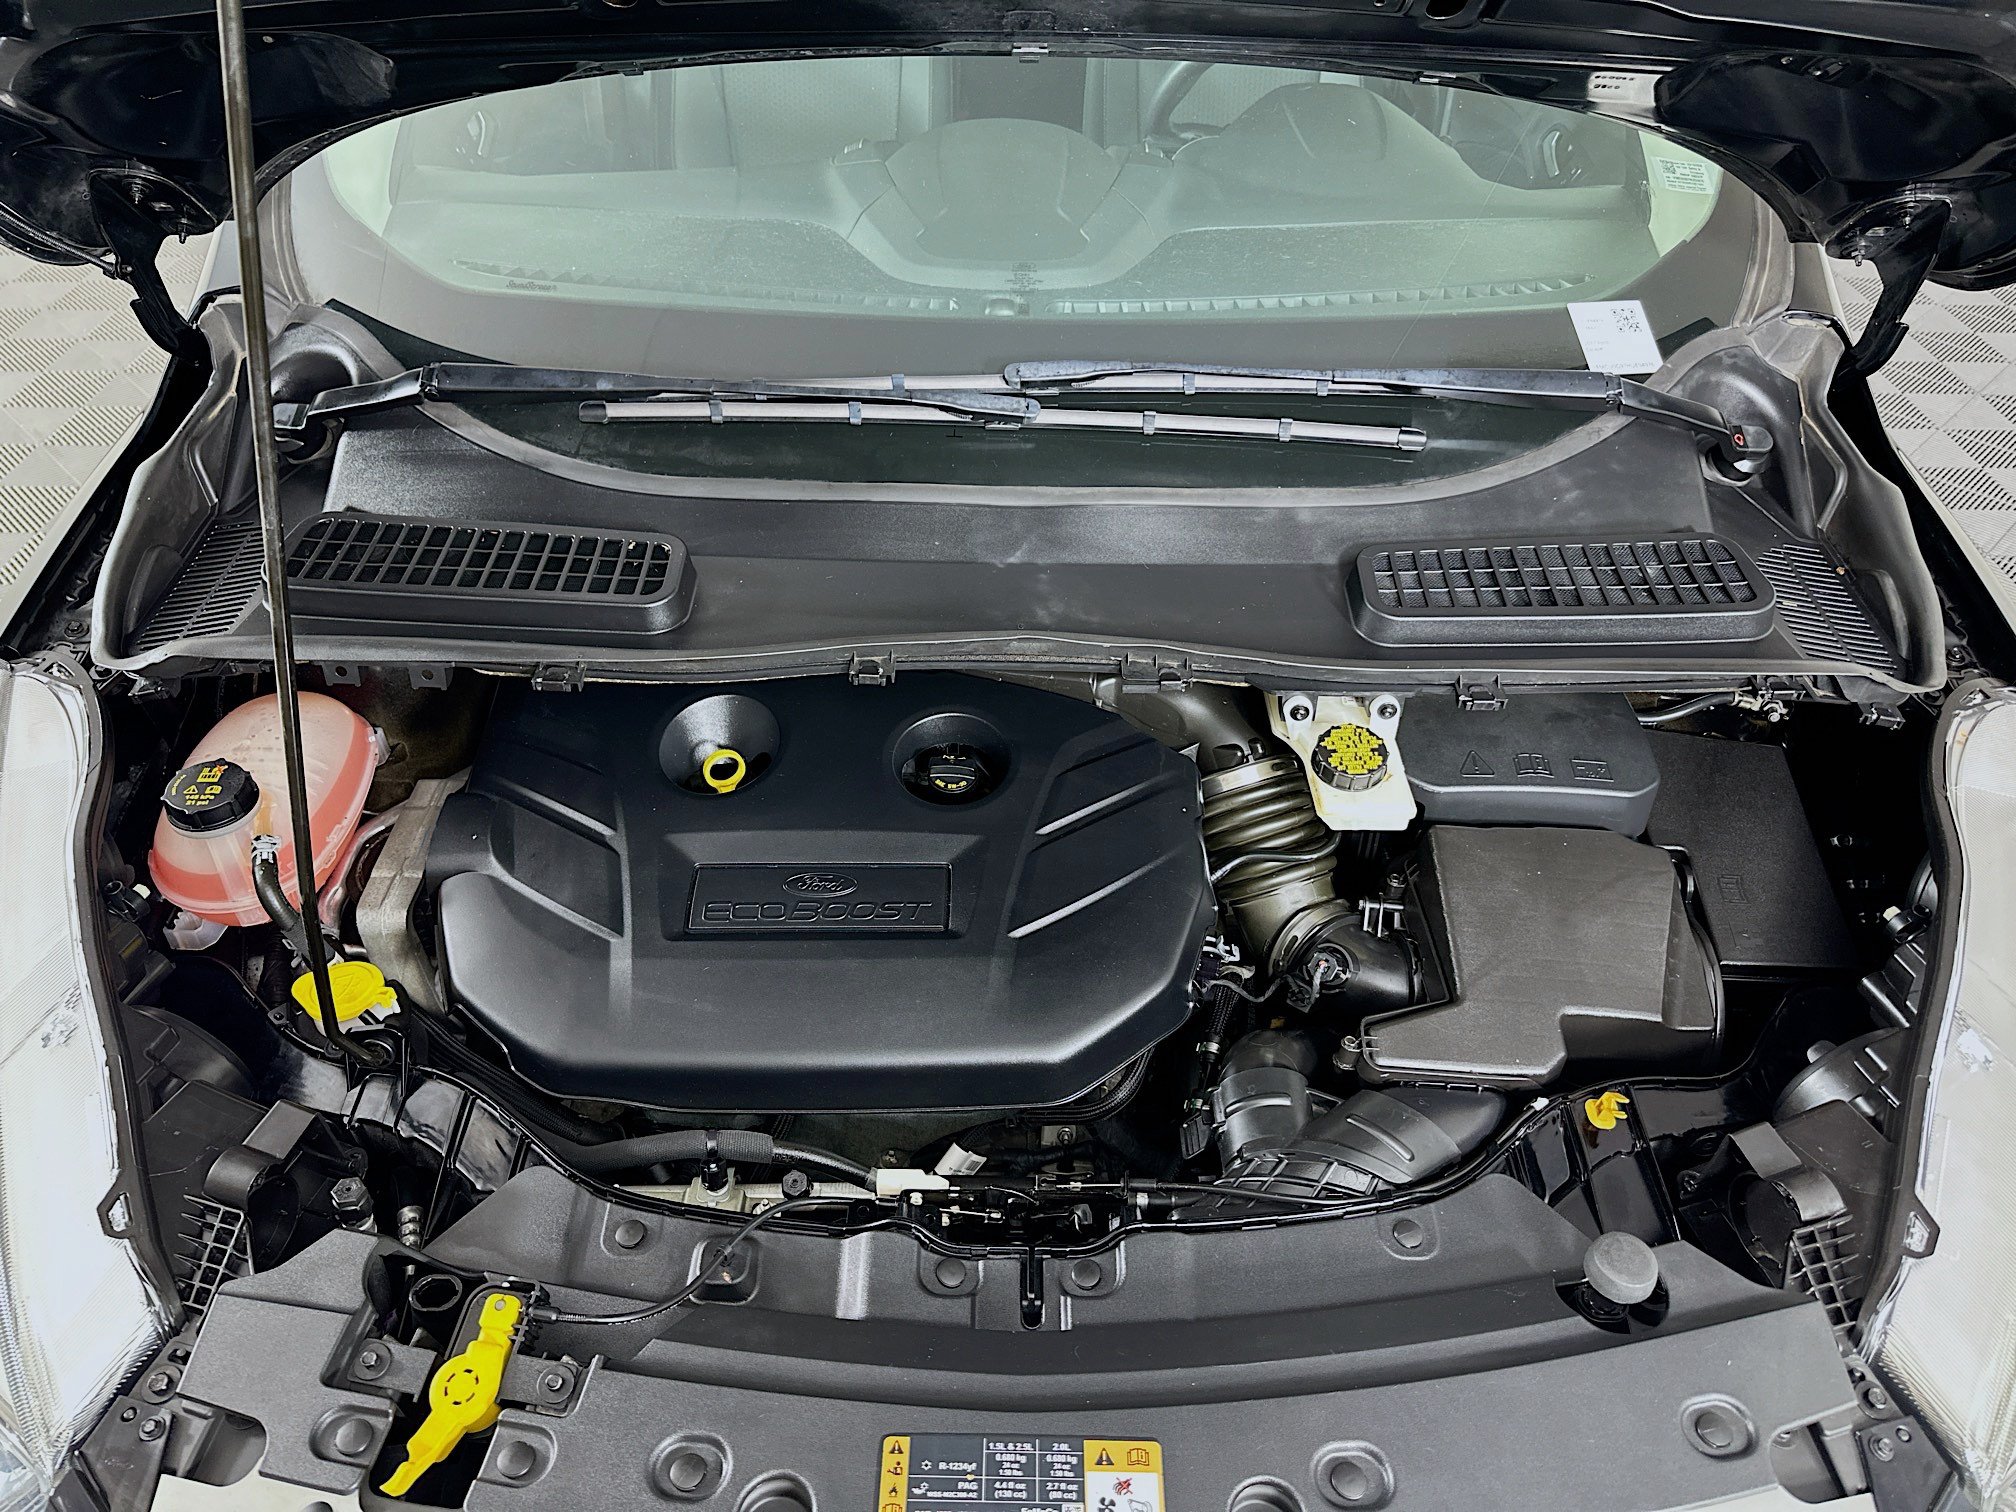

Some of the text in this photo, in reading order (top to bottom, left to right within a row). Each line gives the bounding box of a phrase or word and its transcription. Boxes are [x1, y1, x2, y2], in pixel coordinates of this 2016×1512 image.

[798, 875, 845, 892] Ford
[988, 1442, 1034, 1451] 1.5L & 2.5L
[1052, 1443, 1071, 1451] 2.0L
[1015, 1453, 1027, 1463] kg
[1066, 1455, 1078, 1464] kg
[938, 1462, 977, 1472] R-1234yf
[958, 1481, 978, 1490] PAG
[1046, 1482, 1059, 1491] 2.7
[1013, 1490, 1028, 1500] cc)
[1063, 1492, 1078, 1500] cc)
